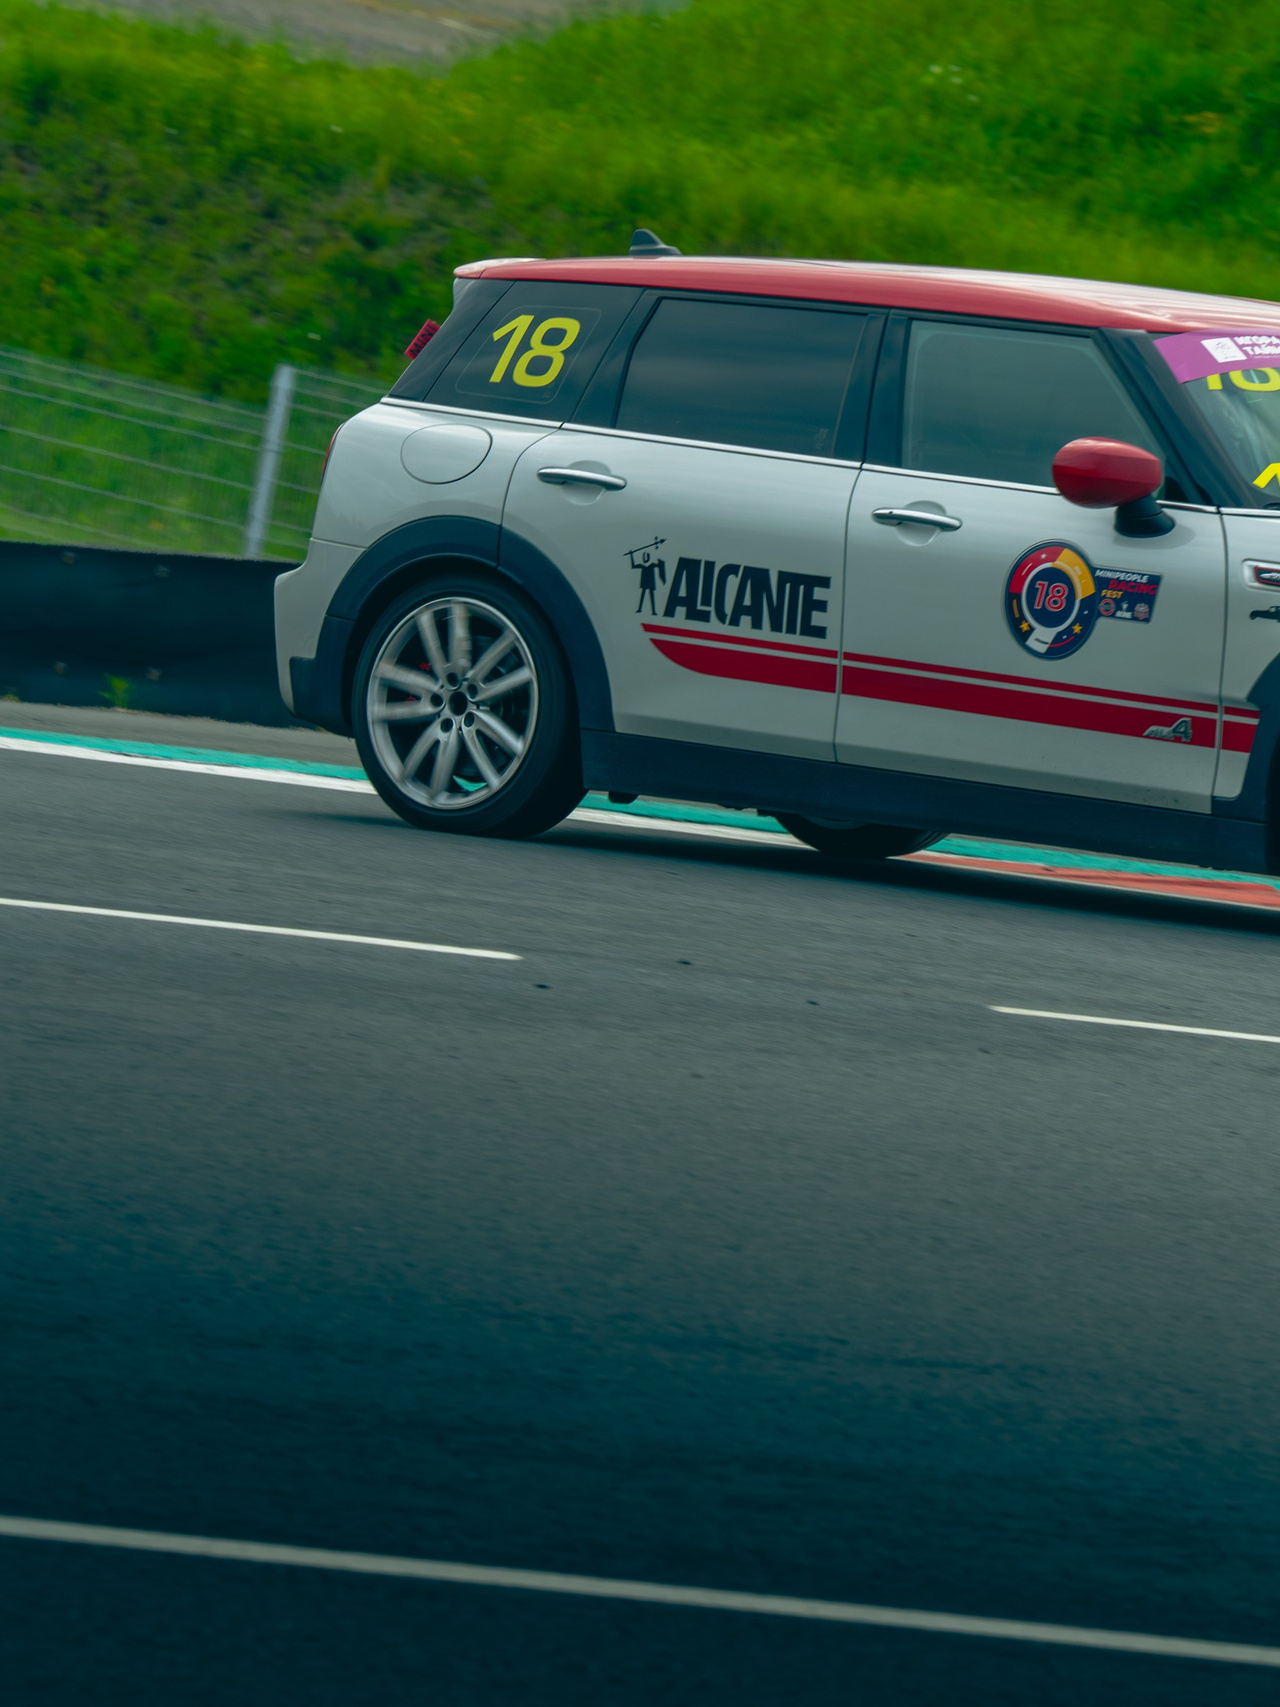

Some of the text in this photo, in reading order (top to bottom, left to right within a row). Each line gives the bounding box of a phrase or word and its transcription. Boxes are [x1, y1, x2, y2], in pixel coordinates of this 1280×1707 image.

[489, 314, 581, 388] 18
[663, 557, 832, 639] ALICANTE
[1033, 580, 1069, 612] 18
[1101, 589, 1124, 599] FEST
[1108, 579, 1159, 596] RACING
